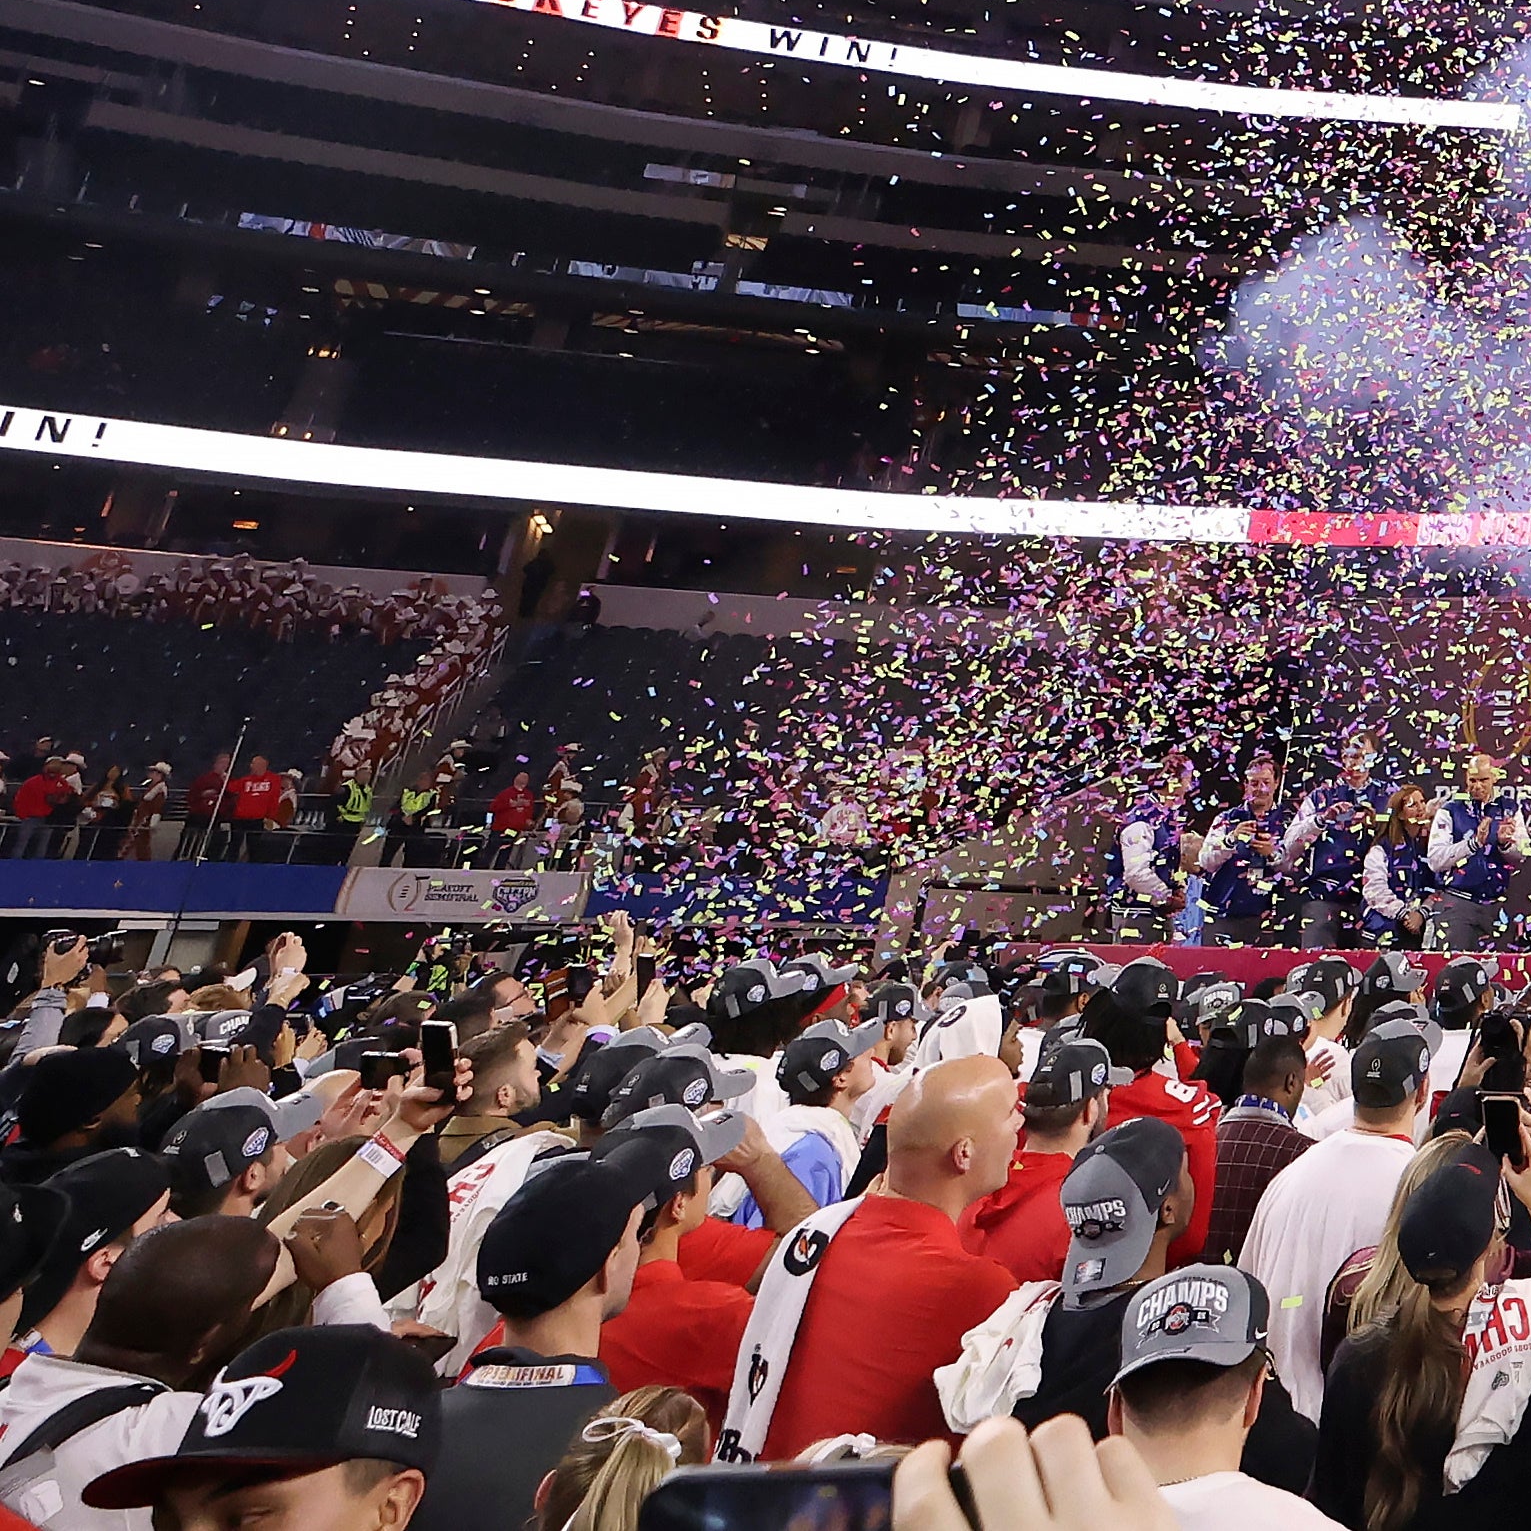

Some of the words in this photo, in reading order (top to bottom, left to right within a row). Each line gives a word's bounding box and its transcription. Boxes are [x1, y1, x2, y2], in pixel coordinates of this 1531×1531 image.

[769, 27, 898, 68] WIN!
[218, 1015, 251, 1035] CHAM
[1065, 1198, 1127, 1225] CHAMPS
[502, 1272, 529, 1285] STATE
[1136, 1280, 1231, 1327] CHAMPS
[367, 1405, 398, 1430] LOST
